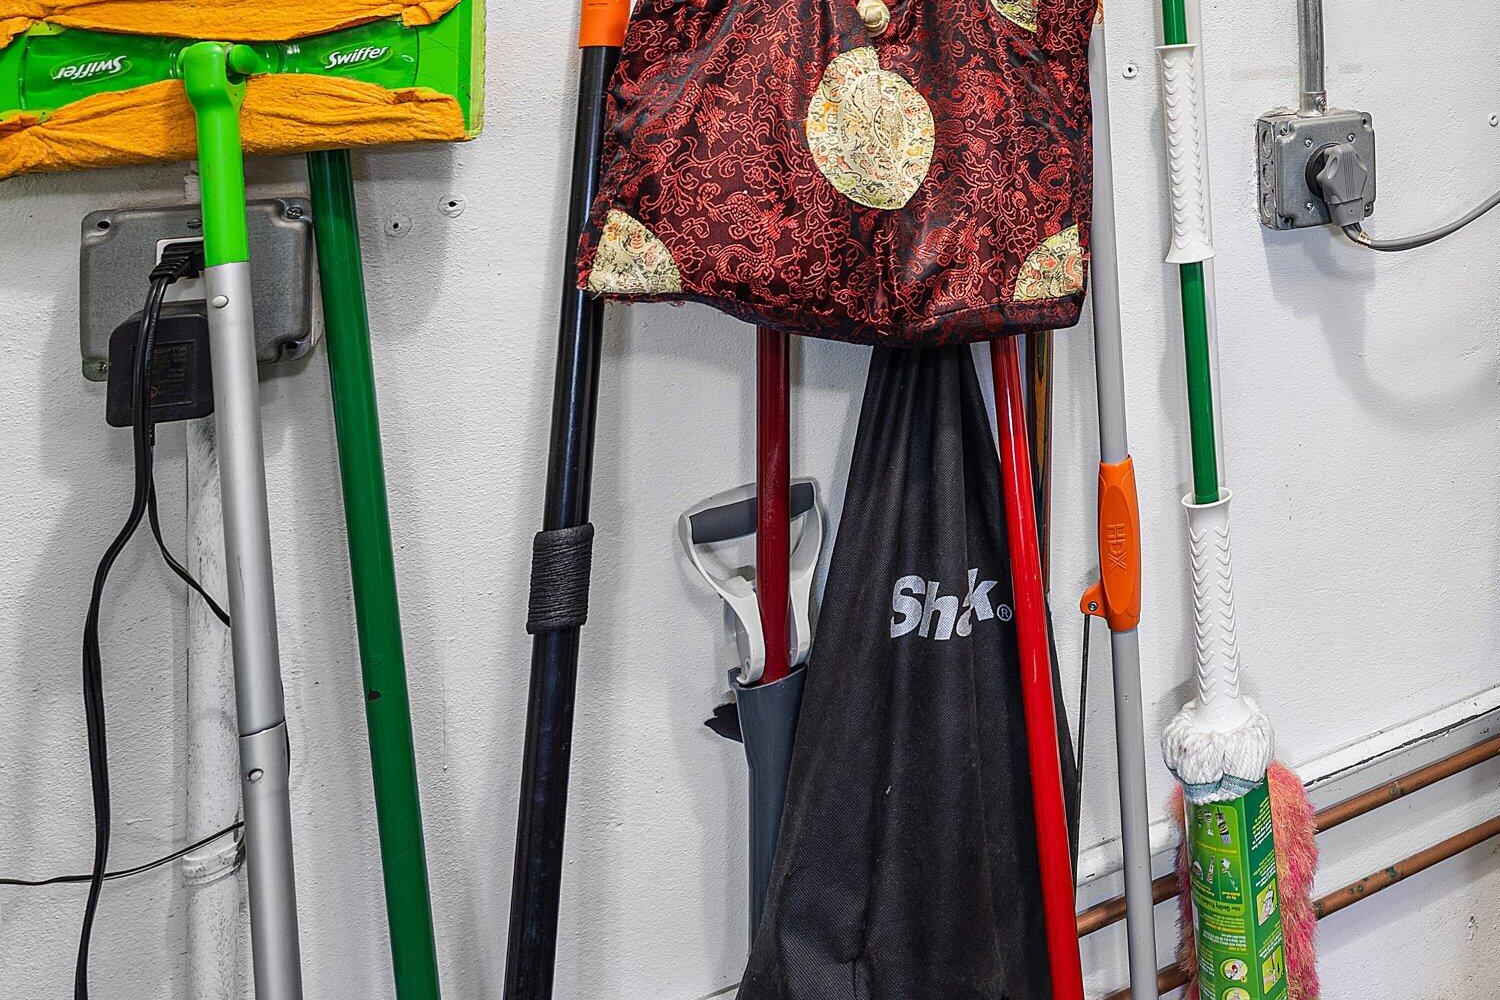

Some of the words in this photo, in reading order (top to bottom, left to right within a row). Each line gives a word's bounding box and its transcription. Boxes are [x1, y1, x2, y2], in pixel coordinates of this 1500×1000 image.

[52, 55, 127, 81] Swiffer
[325, 44, 390, 70] Swiffer
[1107, 523, 1127, 572] HDX
